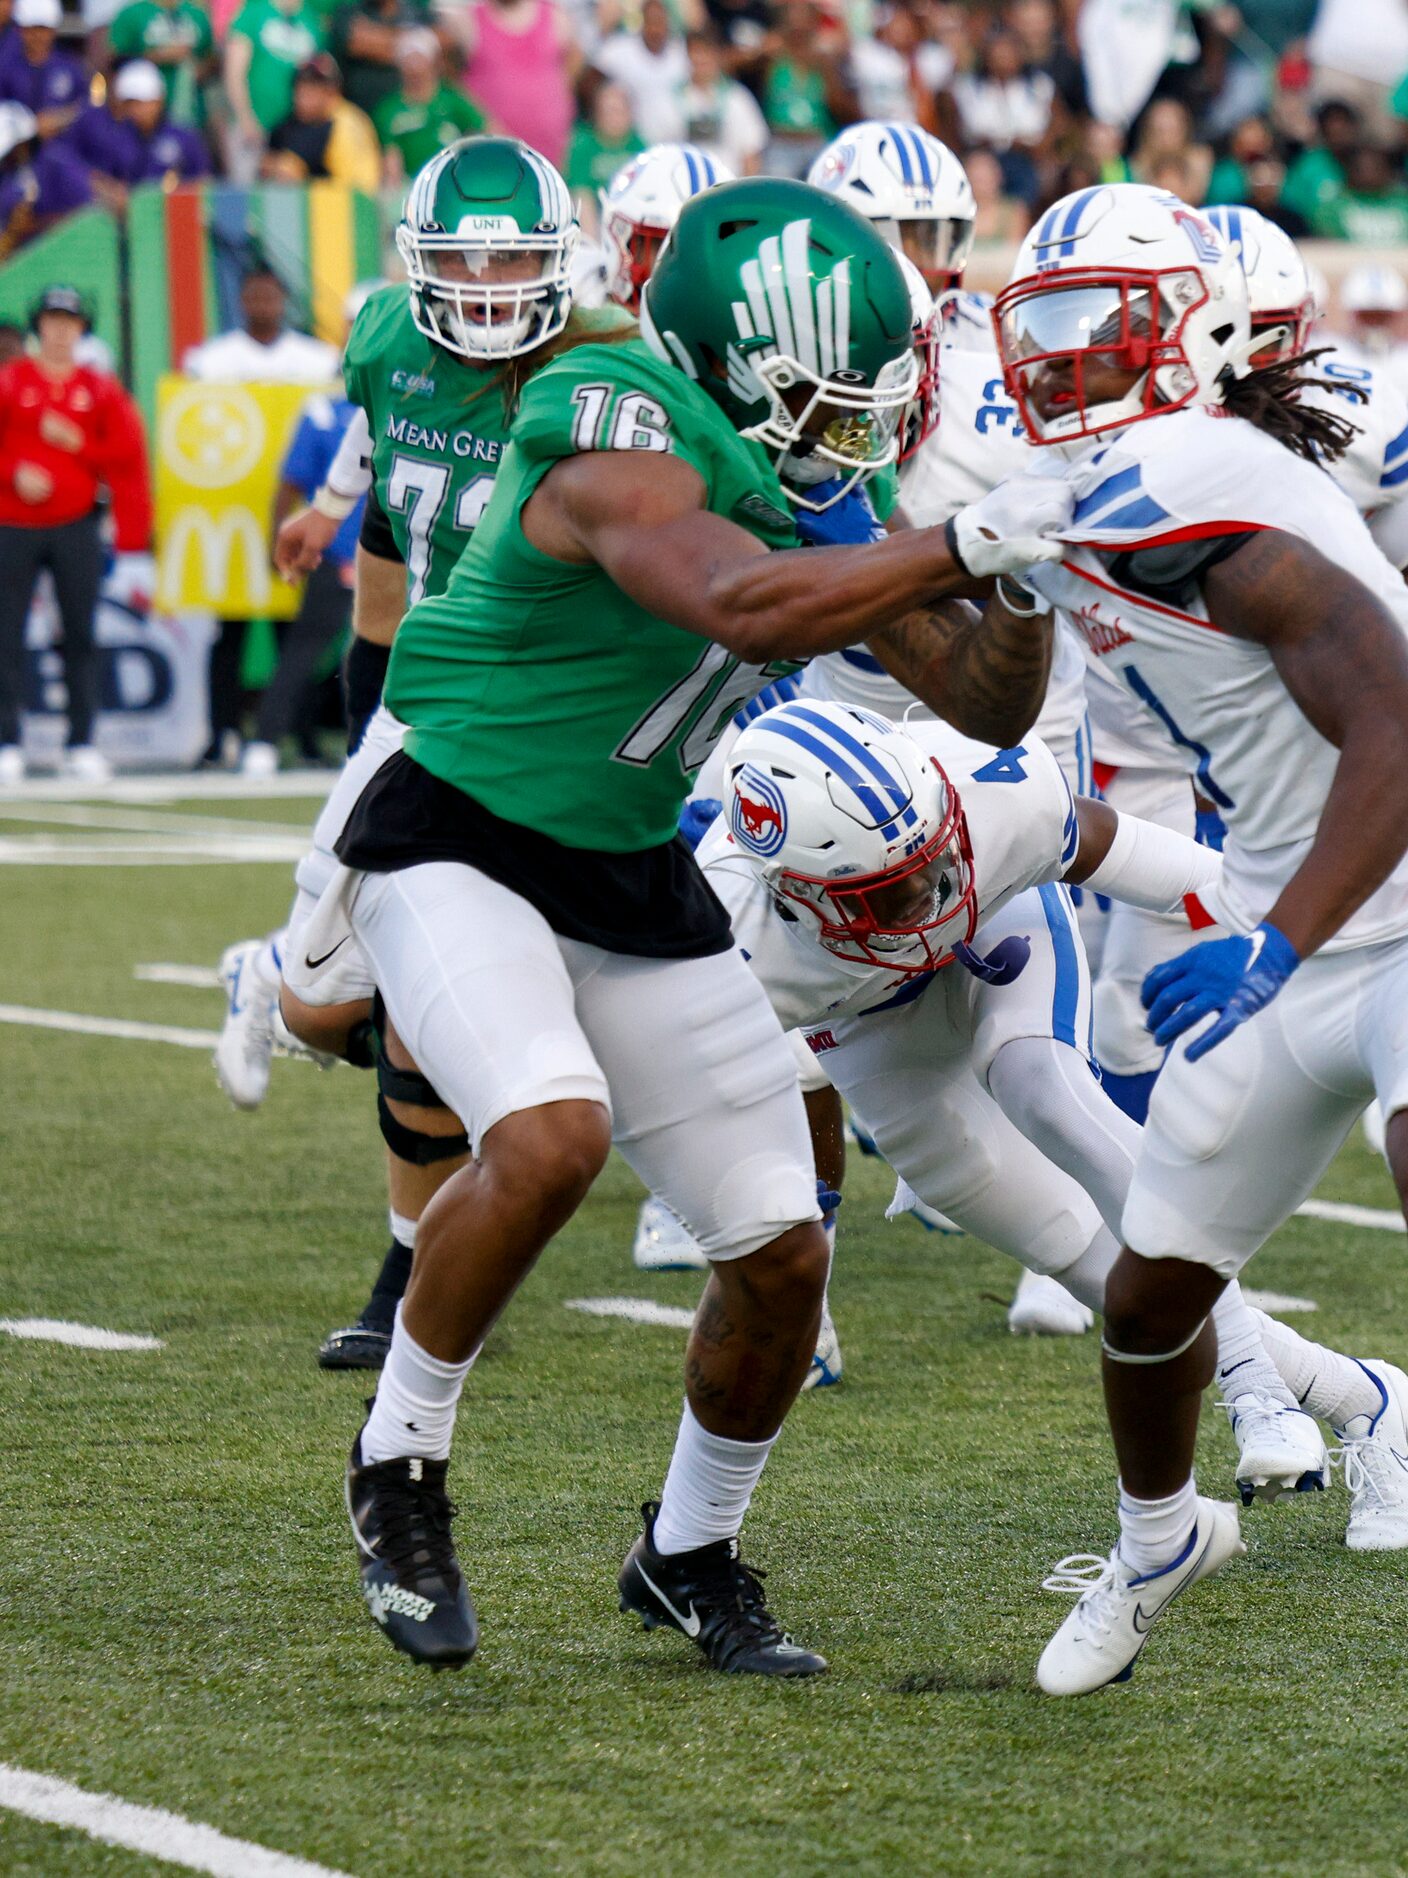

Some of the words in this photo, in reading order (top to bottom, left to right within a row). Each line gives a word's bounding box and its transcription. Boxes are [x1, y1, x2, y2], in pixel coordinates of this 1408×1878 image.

[473, 218, 503, 230] UNT
[387, 412, 448, 452] MEAN
[453, 430, 508, 463] GRE
[570, 381, 675, 454] 16
[609, 640, 813, 777] 16
[971, 745, 1029, 784] 4
[381, 1582, 438, 1613] NORTH
